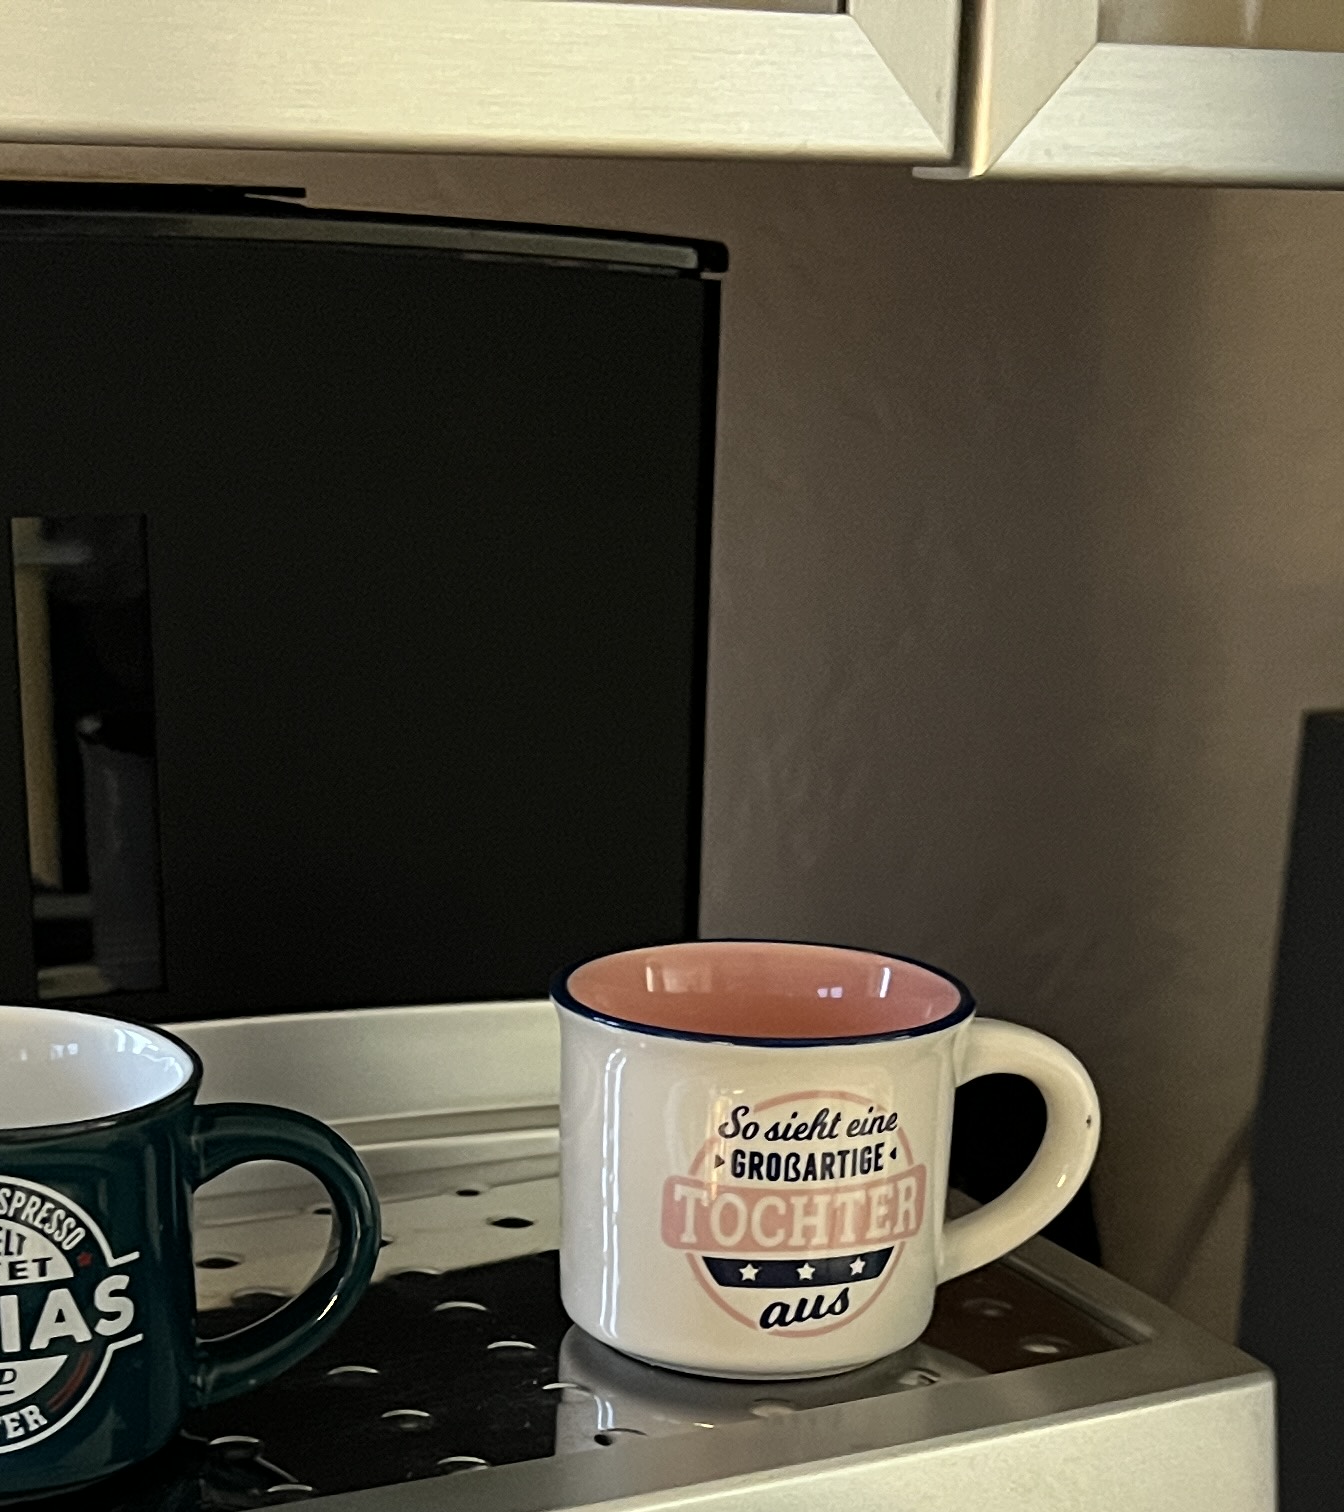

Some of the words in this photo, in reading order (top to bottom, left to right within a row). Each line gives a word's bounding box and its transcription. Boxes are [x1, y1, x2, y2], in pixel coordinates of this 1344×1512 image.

[718, 1105, 760, 1140] So
[764, 1107, 842, 1141] sieht
[846, 1106, 898, 1138] eine
[673, 1175, 918, 1247] TOCHTER
[759, 1287, 850, 1329] aus
